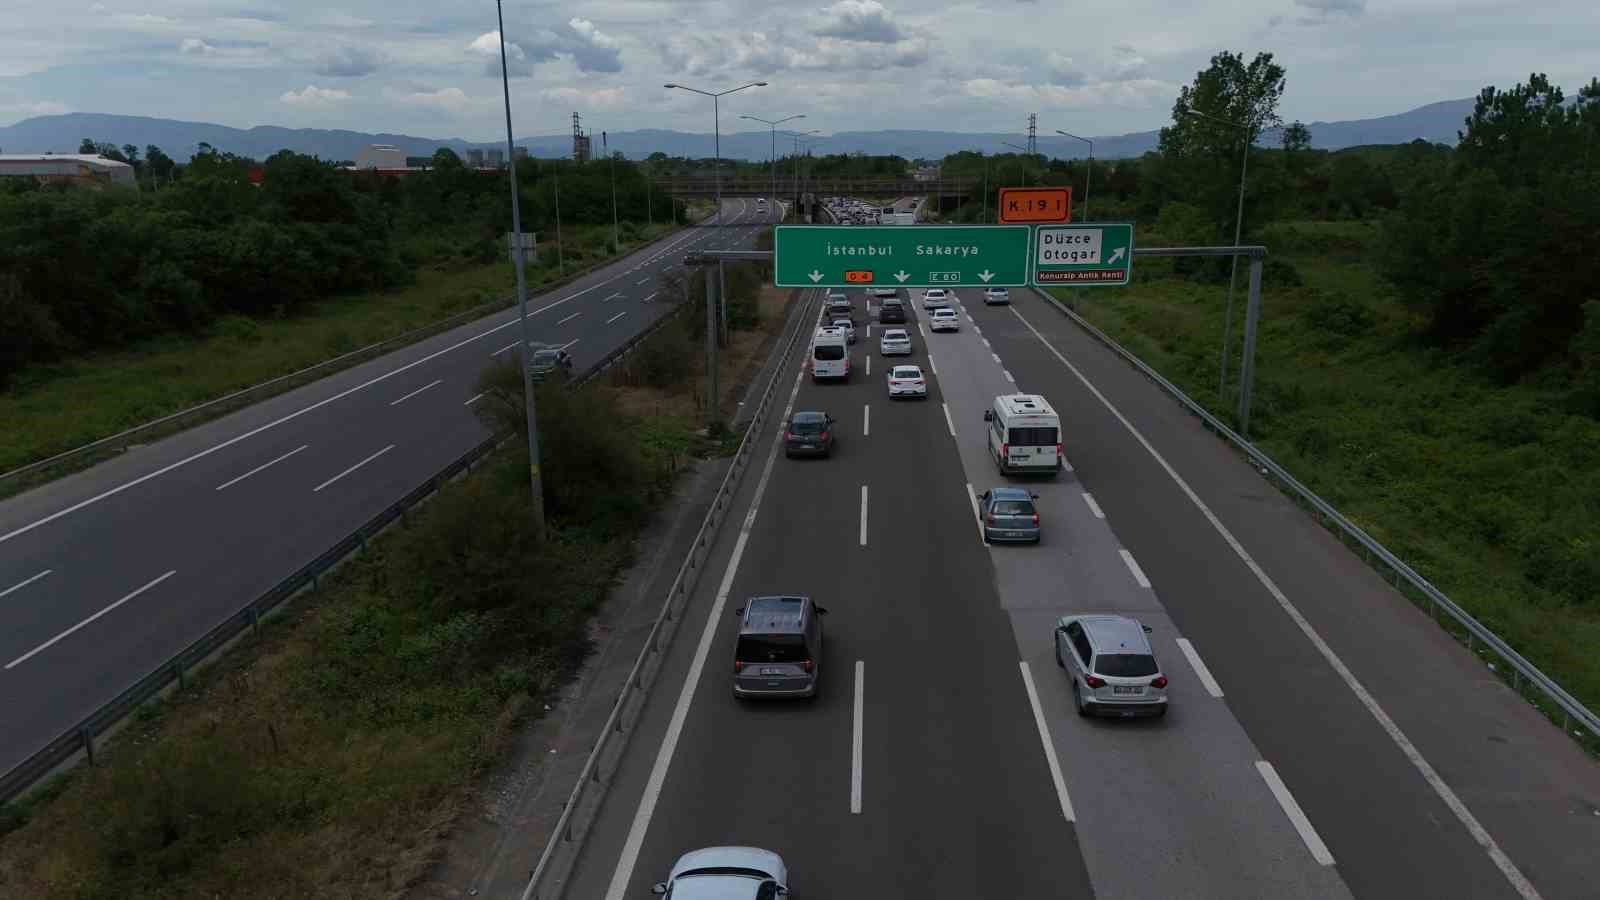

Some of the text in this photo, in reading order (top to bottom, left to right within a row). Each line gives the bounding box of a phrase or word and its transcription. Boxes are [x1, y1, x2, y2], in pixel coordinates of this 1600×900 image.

[1044, 231, 1091, 244] Düzce
[827, 241, 979, 257] İstanbul Sakarya
[1044, 250, 1096, 262] Otogar
